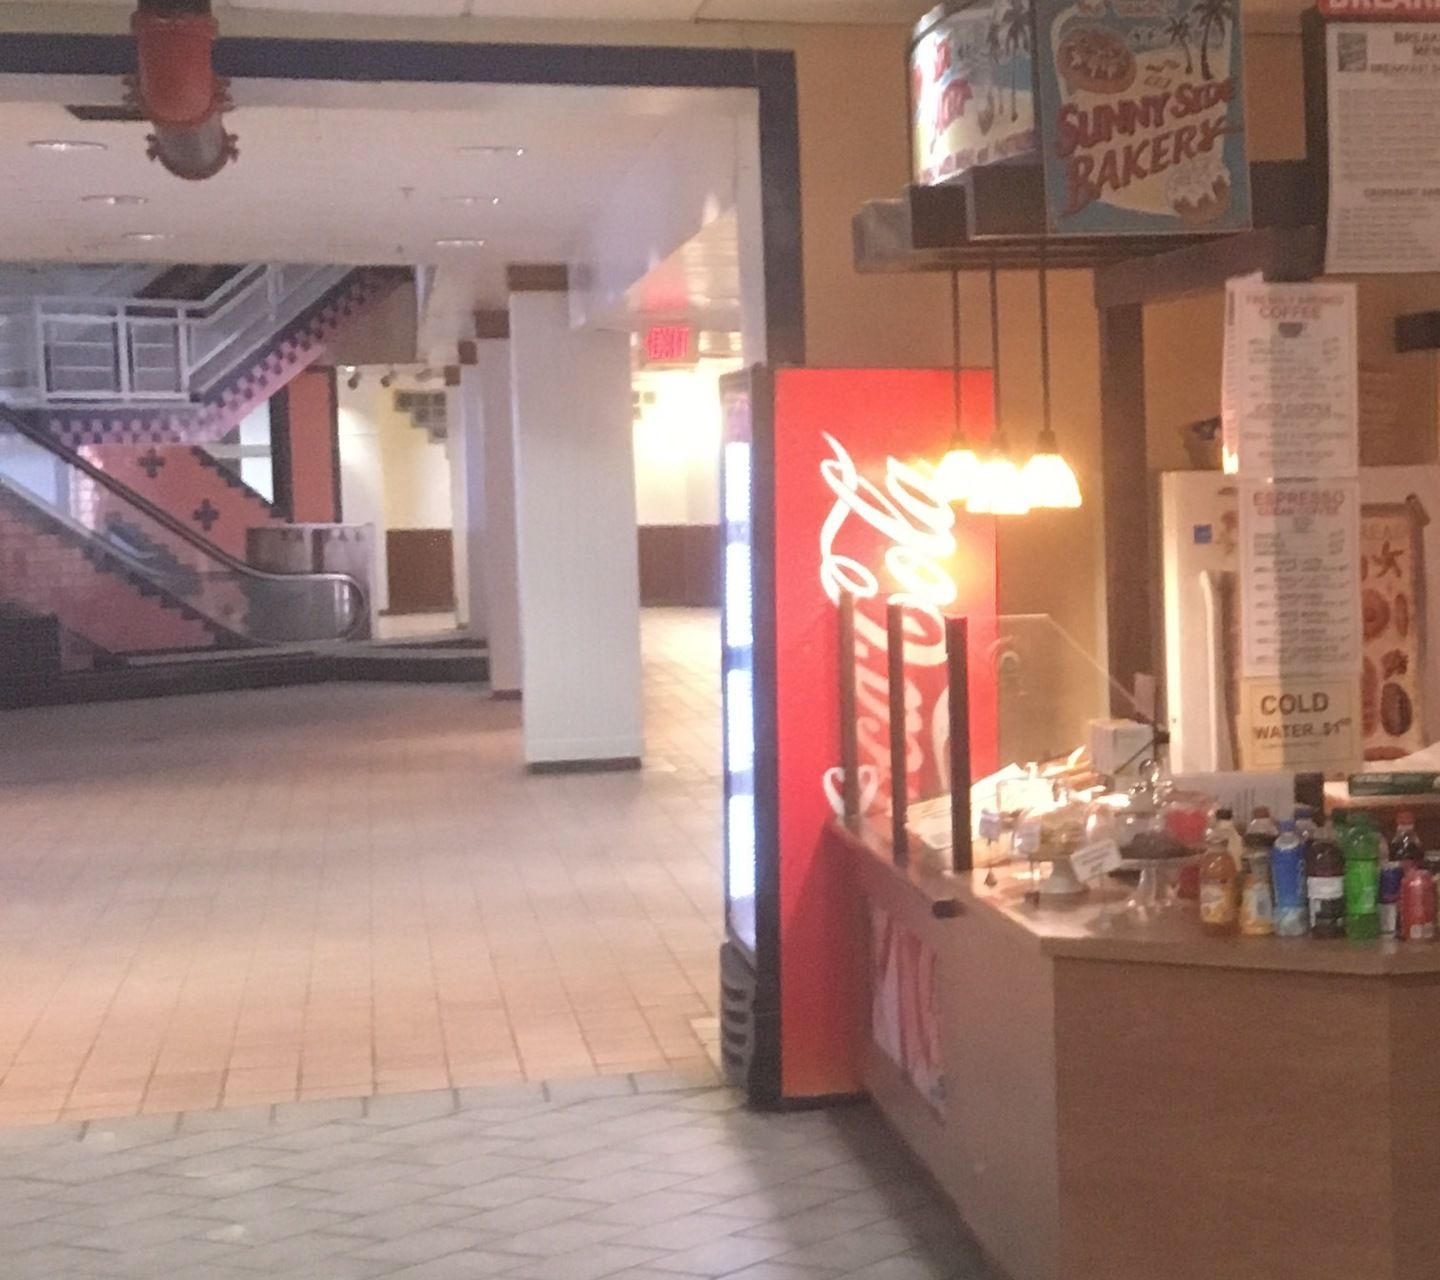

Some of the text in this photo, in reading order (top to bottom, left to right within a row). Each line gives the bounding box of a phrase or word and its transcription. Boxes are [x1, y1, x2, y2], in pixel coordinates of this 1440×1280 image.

[1055, 92, 1173, 160] SUNNY
[1060, 115, 1243, 216] BAKERY
[1258, 305, 1321, 320] COFFEE
[1253, 489, 1346, 506] ESPRESSO
[1260, 691, 1329, 716] COLD
[1252, 722, 1314, 740] WATER
